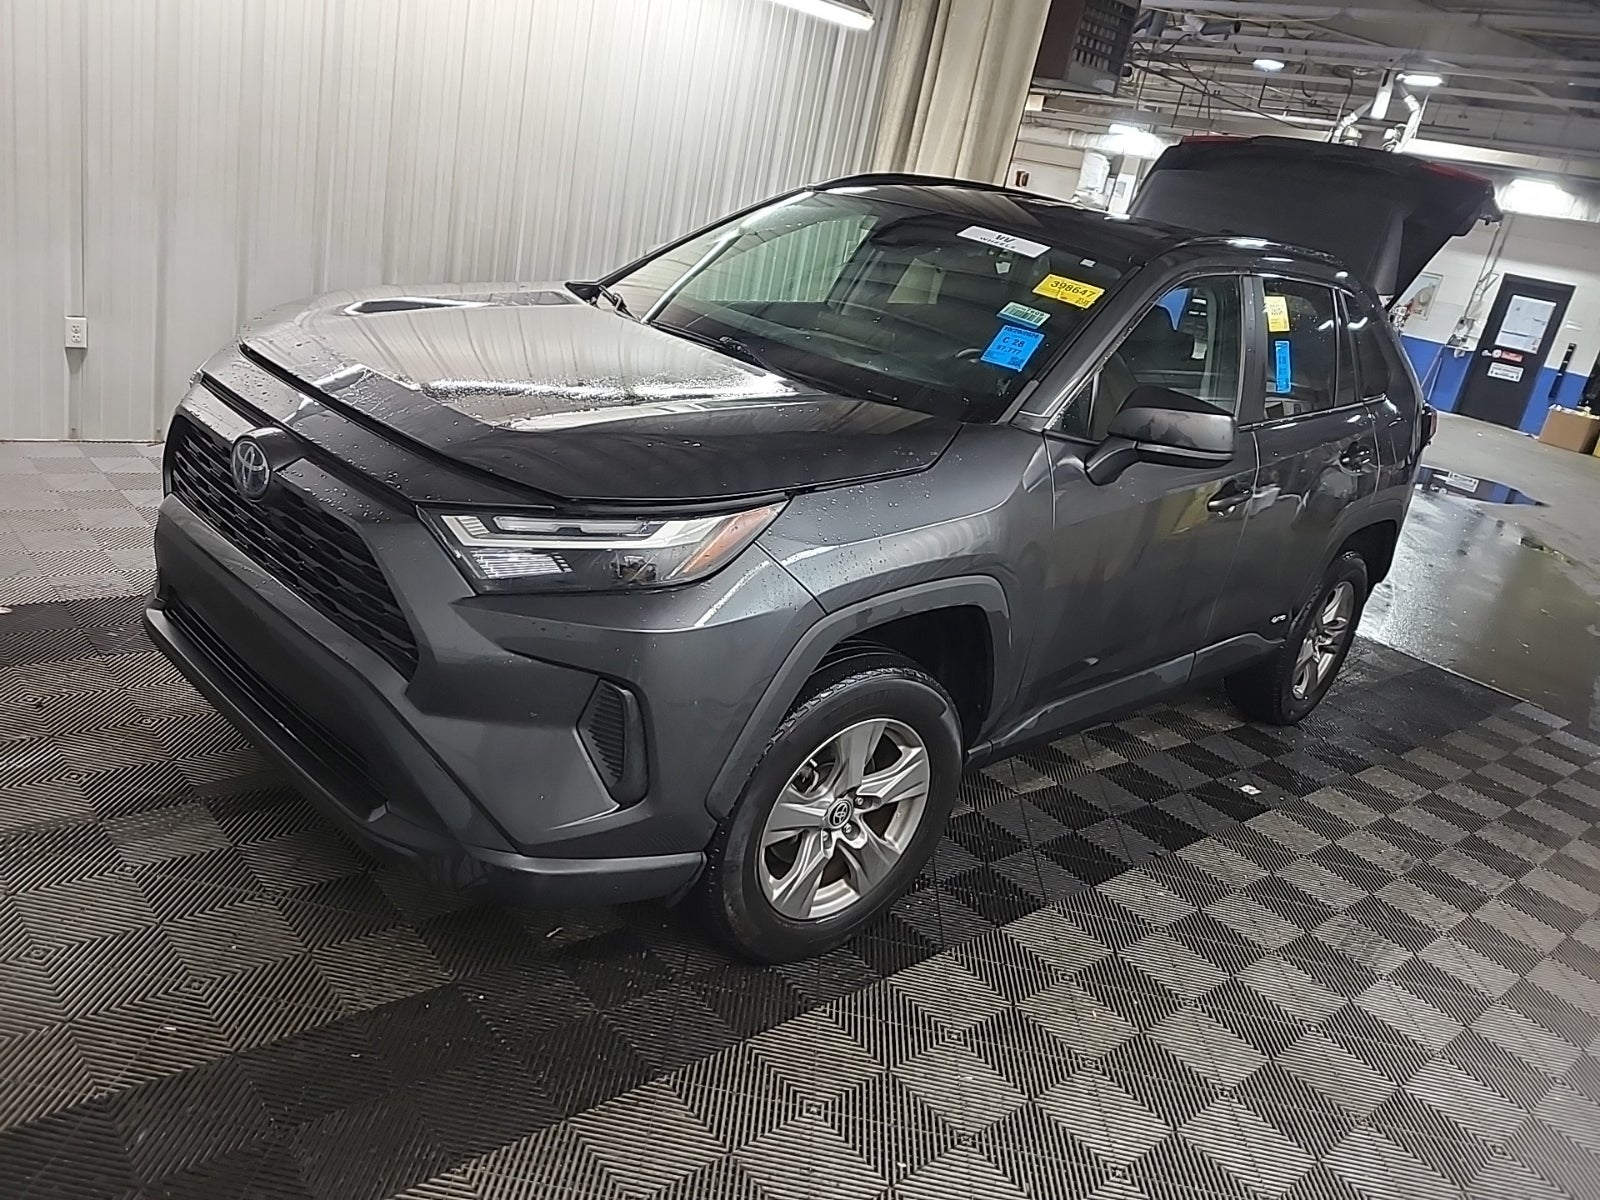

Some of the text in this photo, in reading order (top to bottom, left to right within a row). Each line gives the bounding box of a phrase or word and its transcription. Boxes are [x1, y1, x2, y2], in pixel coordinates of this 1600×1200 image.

[1050, 281, 1096, 298] 398647
[1002, 336, 1026, 348] C 28
